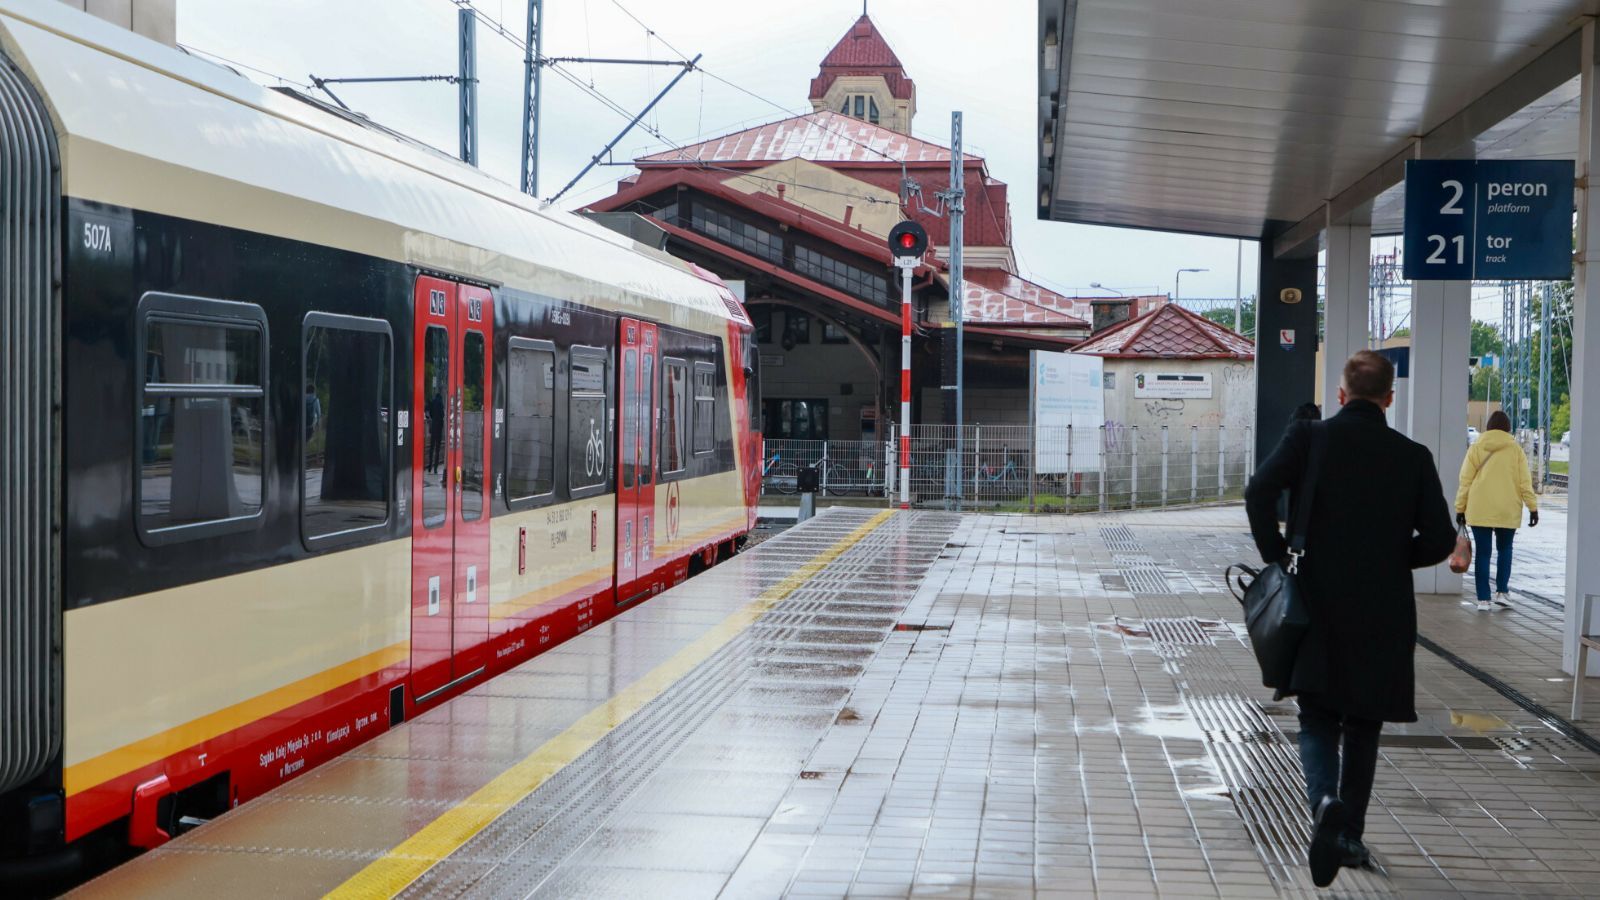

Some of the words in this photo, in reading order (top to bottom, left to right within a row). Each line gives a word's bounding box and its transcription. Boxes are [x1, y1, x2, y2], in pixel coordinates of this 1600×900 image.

[1440, 179, 1464, 215] 2
[1487, 181, 1548, 201] peron
[1487, 202, 1531, 215] platform
[84, 222, 112, 252] 507A
[1486, 234, 1513, 249] tor
[1425, 234, 1465, 265] 21
[1485, 254, 1507, 263] track
[275, 742, 287, 760] Kolej
